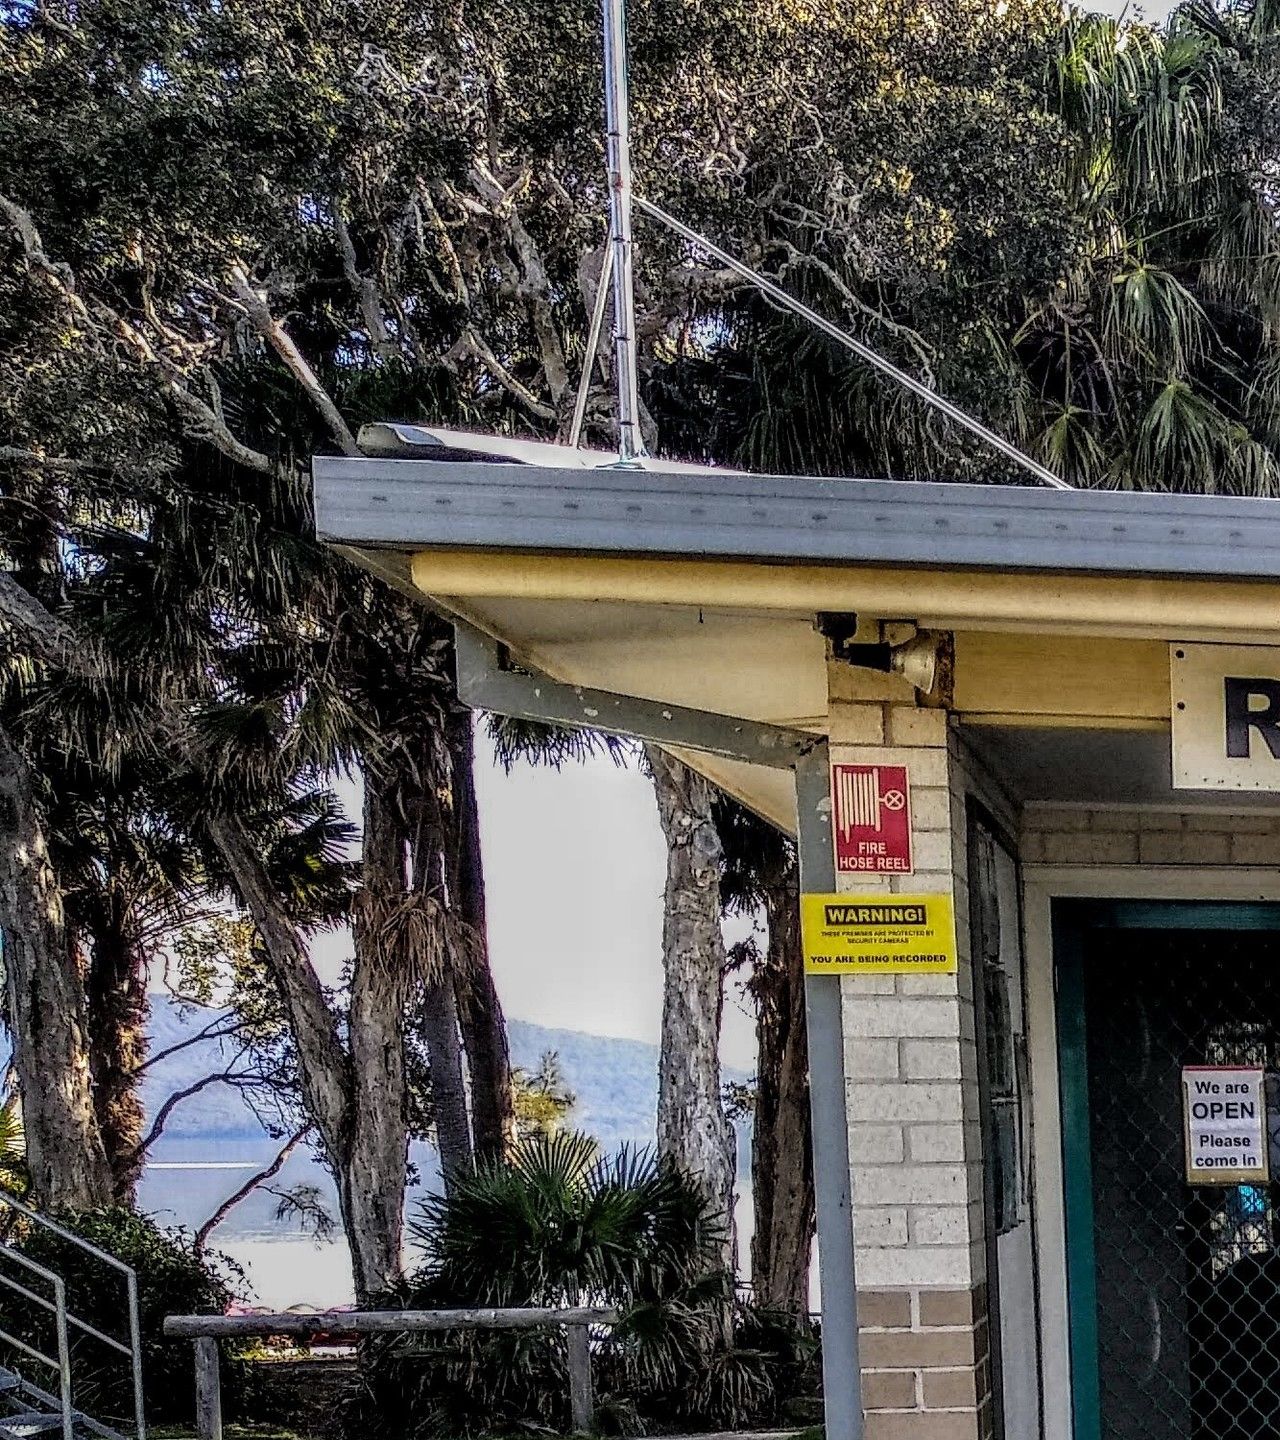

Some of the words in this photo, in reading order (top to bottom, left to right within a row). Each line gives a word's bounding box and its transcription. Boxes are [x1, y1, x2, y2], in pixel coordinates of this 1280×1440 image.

[858, 842, 887, 855] FIRE
[839, 857, 875, 870] HOSE
[877, 858, 911, 871] REEL
[827, 908, 924, 923] WARNING!
[810, 955, 832, 964] YOU
[835, 955, 855, 964] ARE
[858, 955, 890, 963] BEING
[892, 954, 947, 963] RECORDED
[1195, 1081, 1220, 1095] We
[1225, 1083, 1250, 1095] are
[1192, 1102, 1255, 1120] OPEN
[1199, 1133, 1251, 1148] Please
[1195, 1156, 1238, 1167] come
